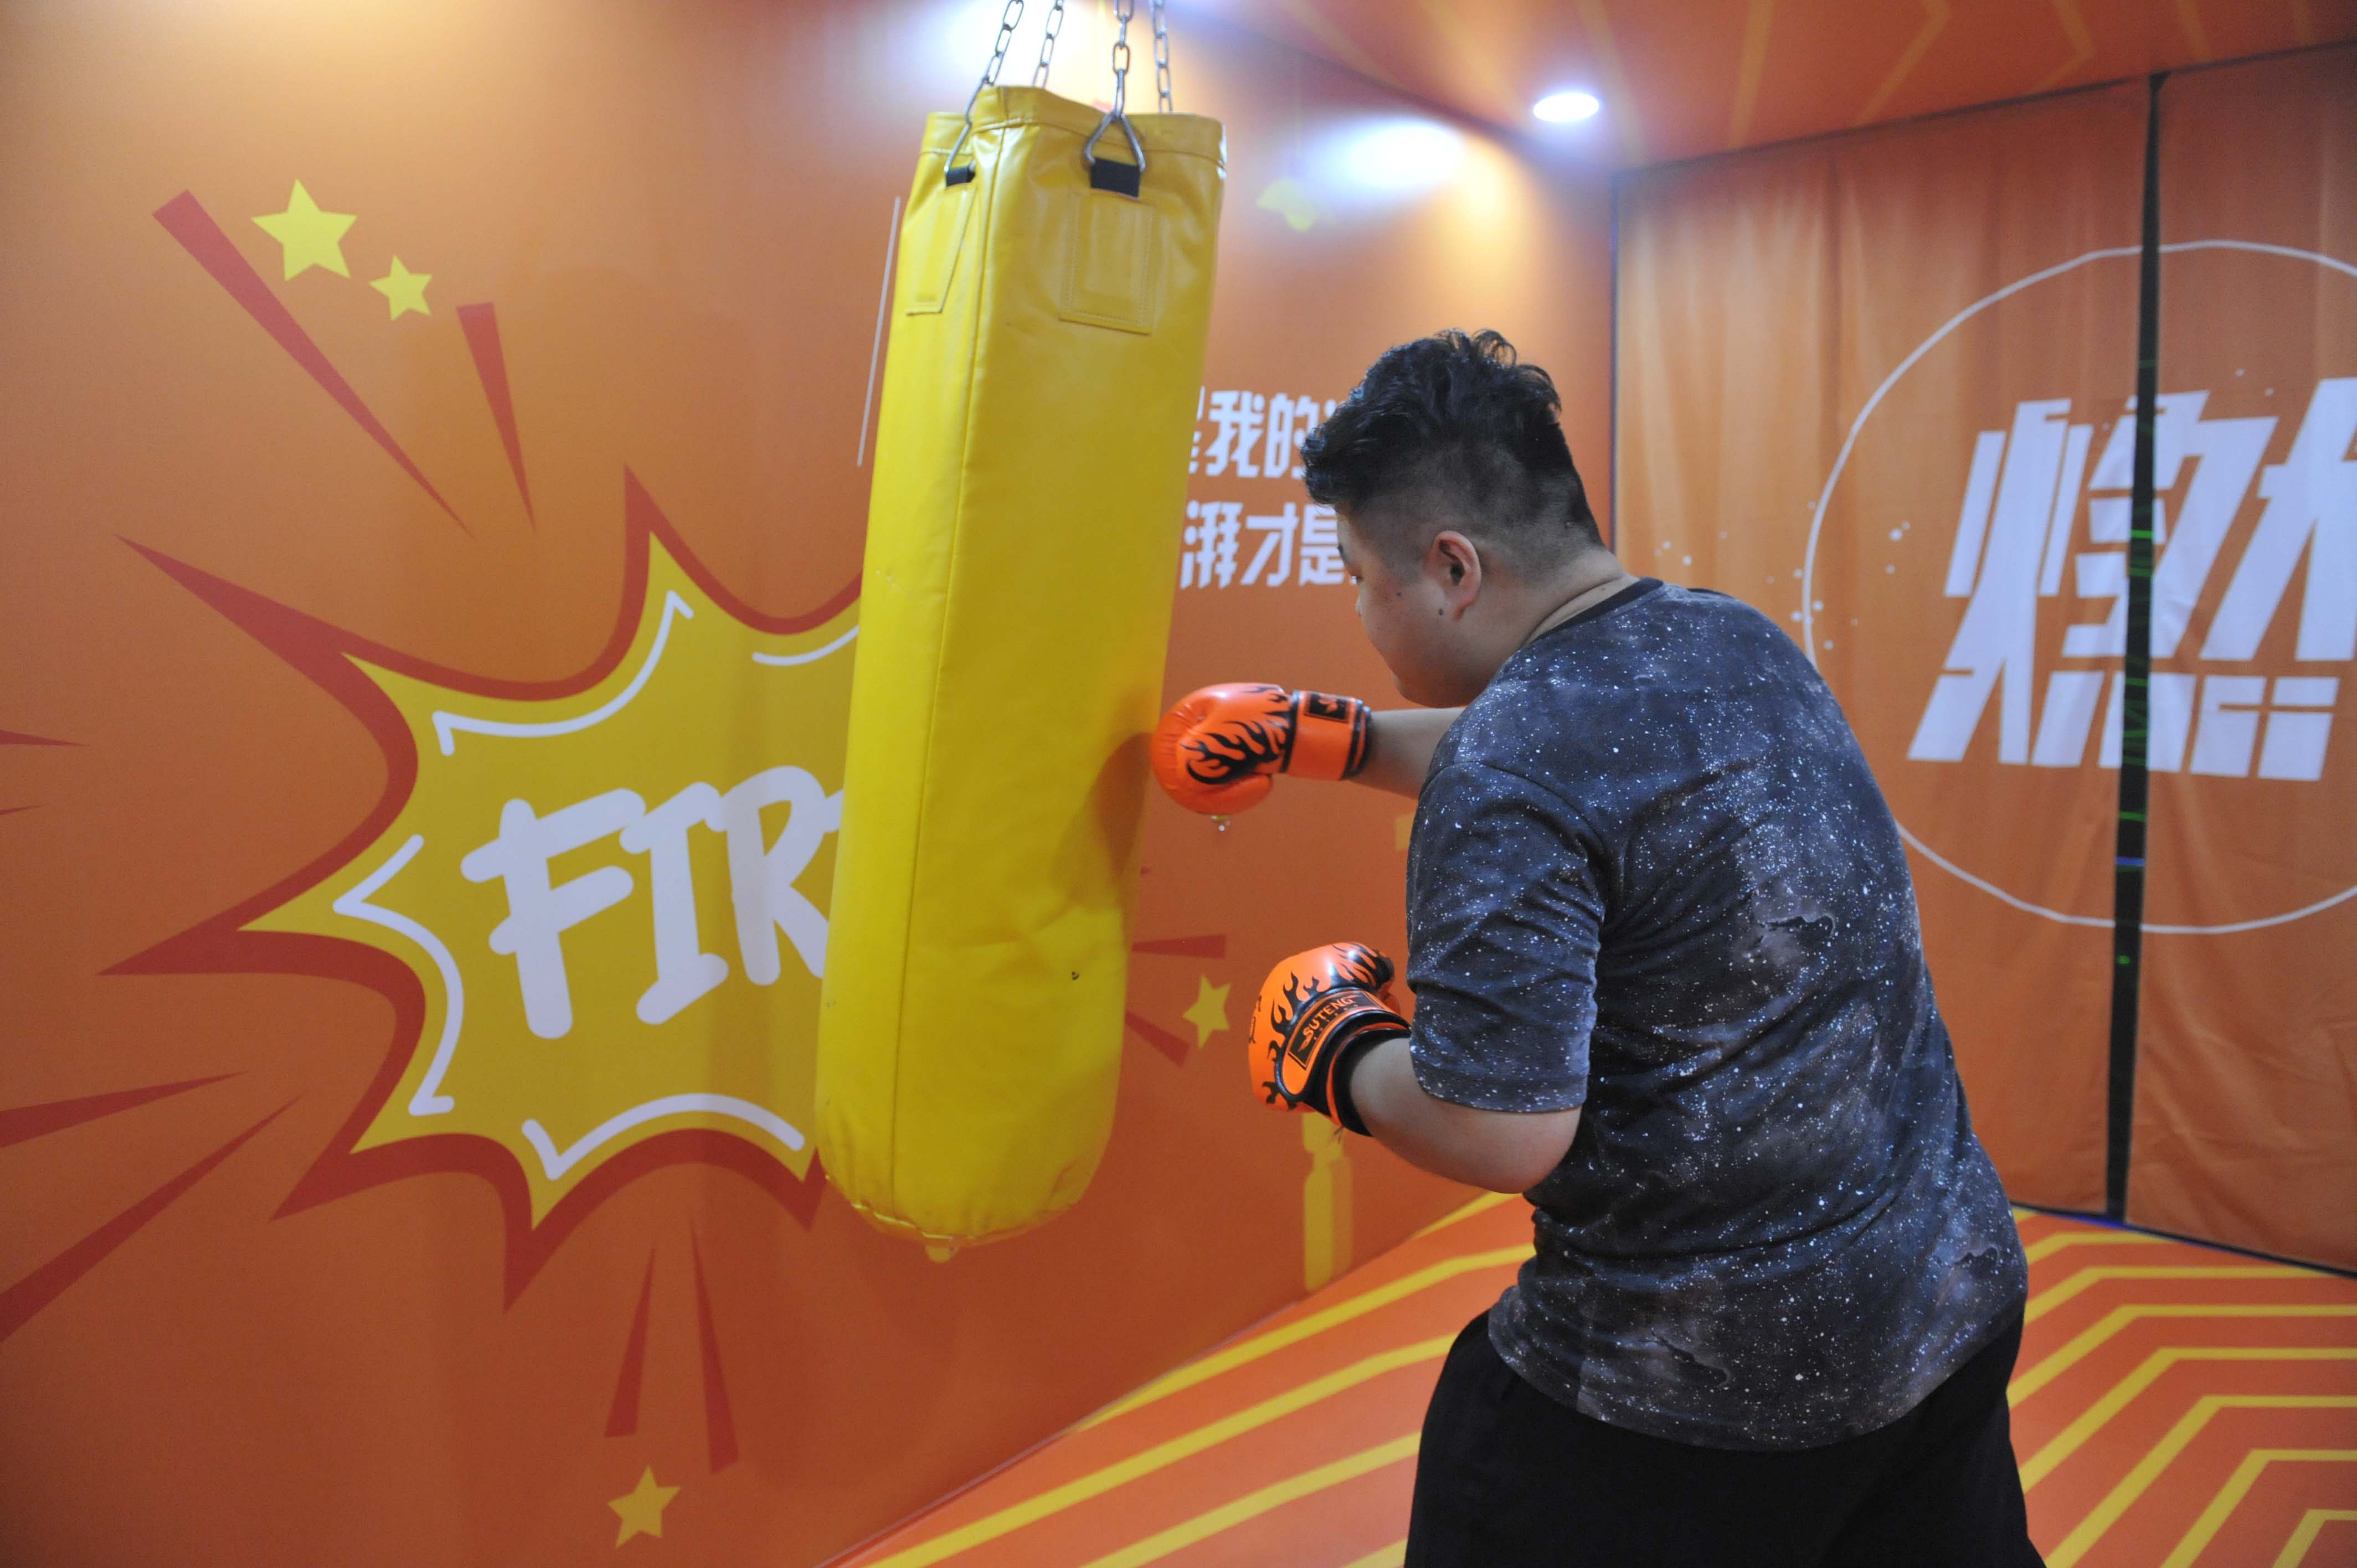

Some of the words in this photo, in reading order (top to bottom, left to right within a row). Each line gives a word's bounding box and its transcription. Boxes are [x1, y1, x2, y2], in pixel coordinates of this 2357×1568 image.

[1188, 386, 1337, 479] 我的
[1180, 500, 1357, 589] 湃才是
[460, 765, 844, 1039] FIR
[1300, 996, 1358, 1045] SUTENG
